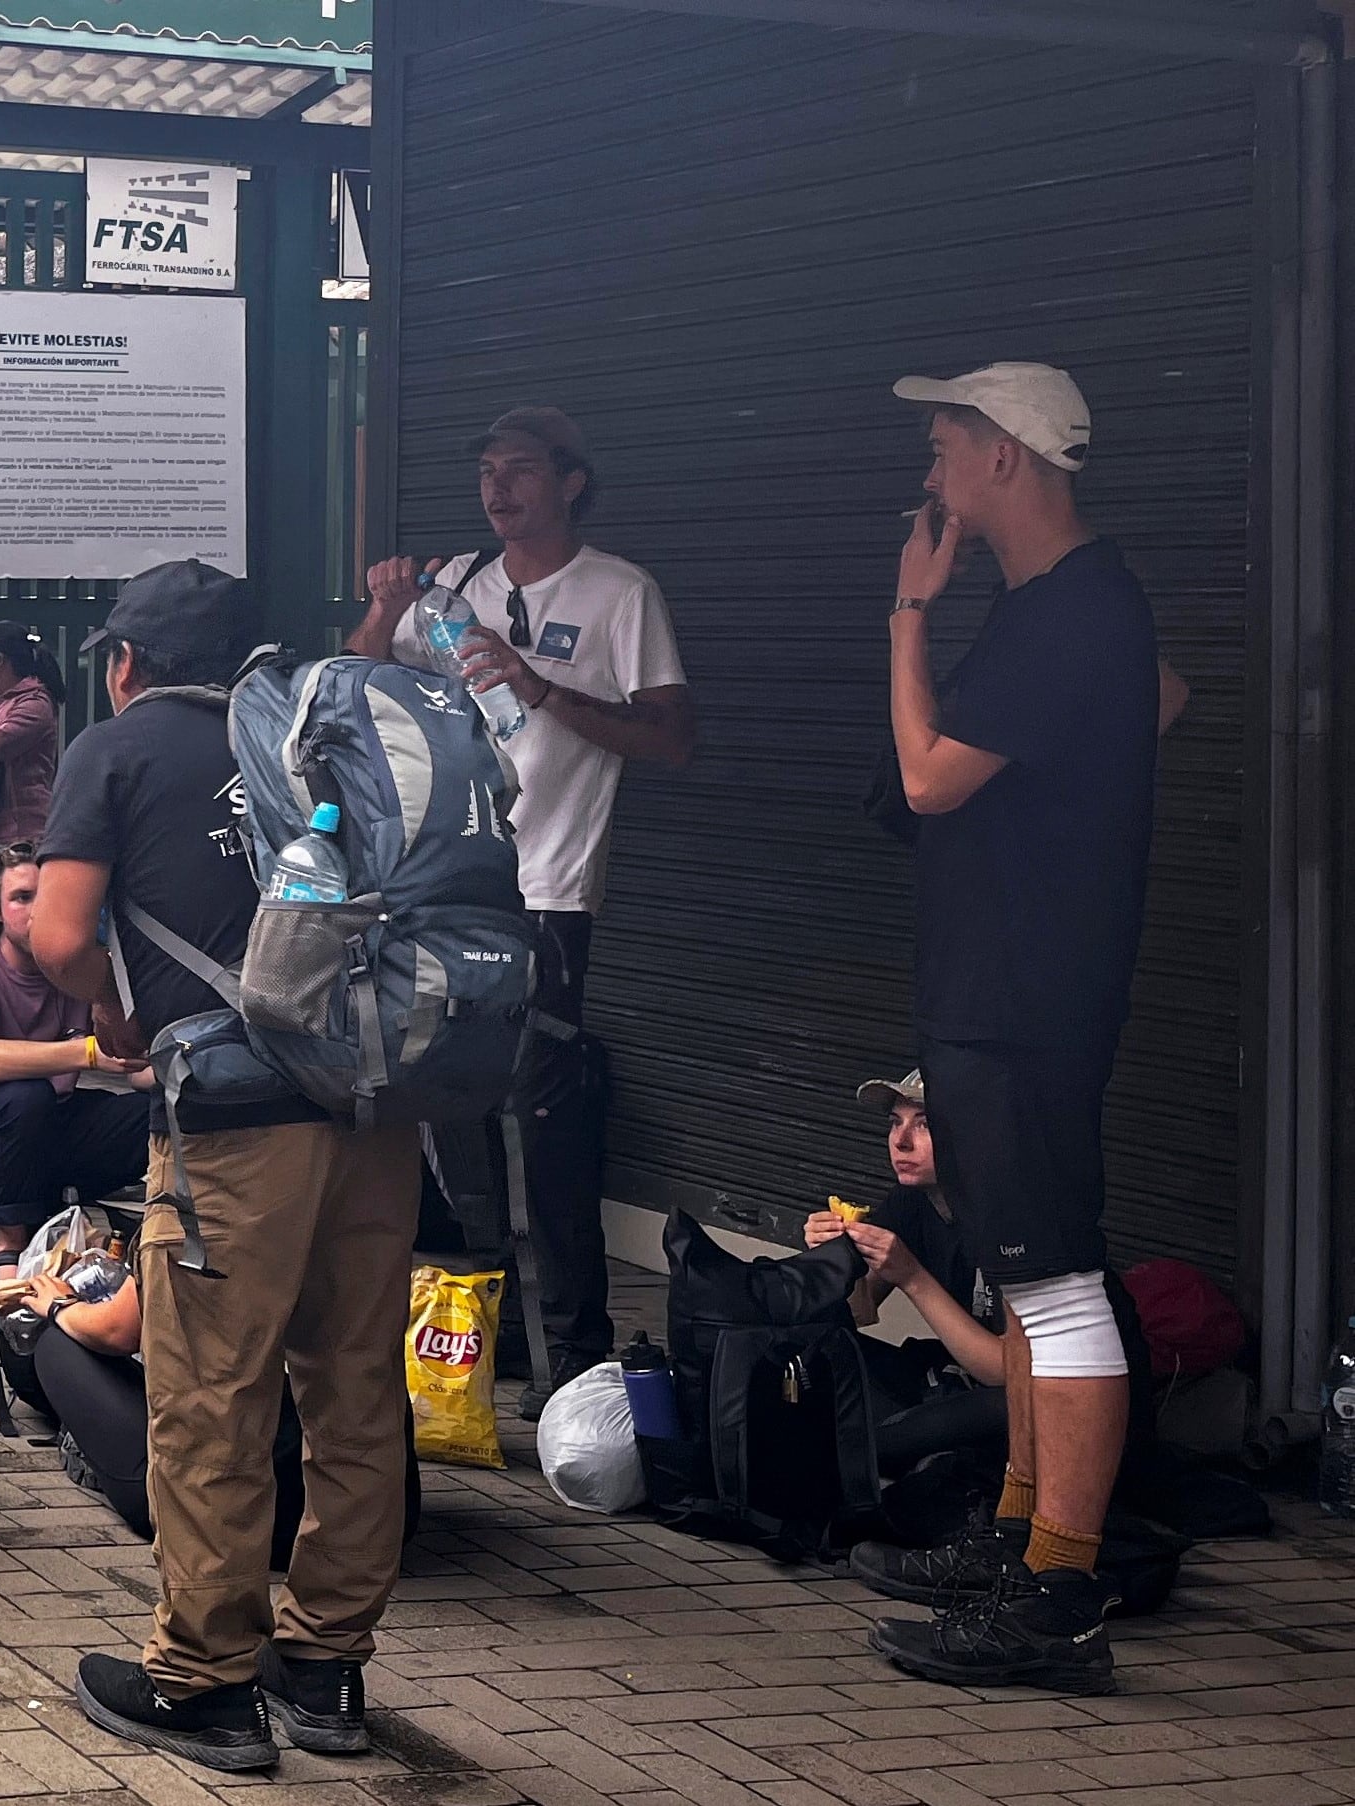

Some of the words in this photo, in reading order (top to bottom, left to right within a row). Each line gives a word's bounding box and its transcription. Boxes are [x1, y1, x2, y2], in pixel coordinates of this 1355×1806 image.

[92, 218, 188, 254] FTSA
[92, 260, 151, 272] FERROCARRIL
[153, 264, 214, 276] TRANSANDINO
[44, 335, 128, 348] MOLESTIAS!
[3, 356, 63, 366] INFORMACIÓN
[65, 357, 119, 367] IMPORTANTE
[419, 1326, 480, 1366] Lay's
